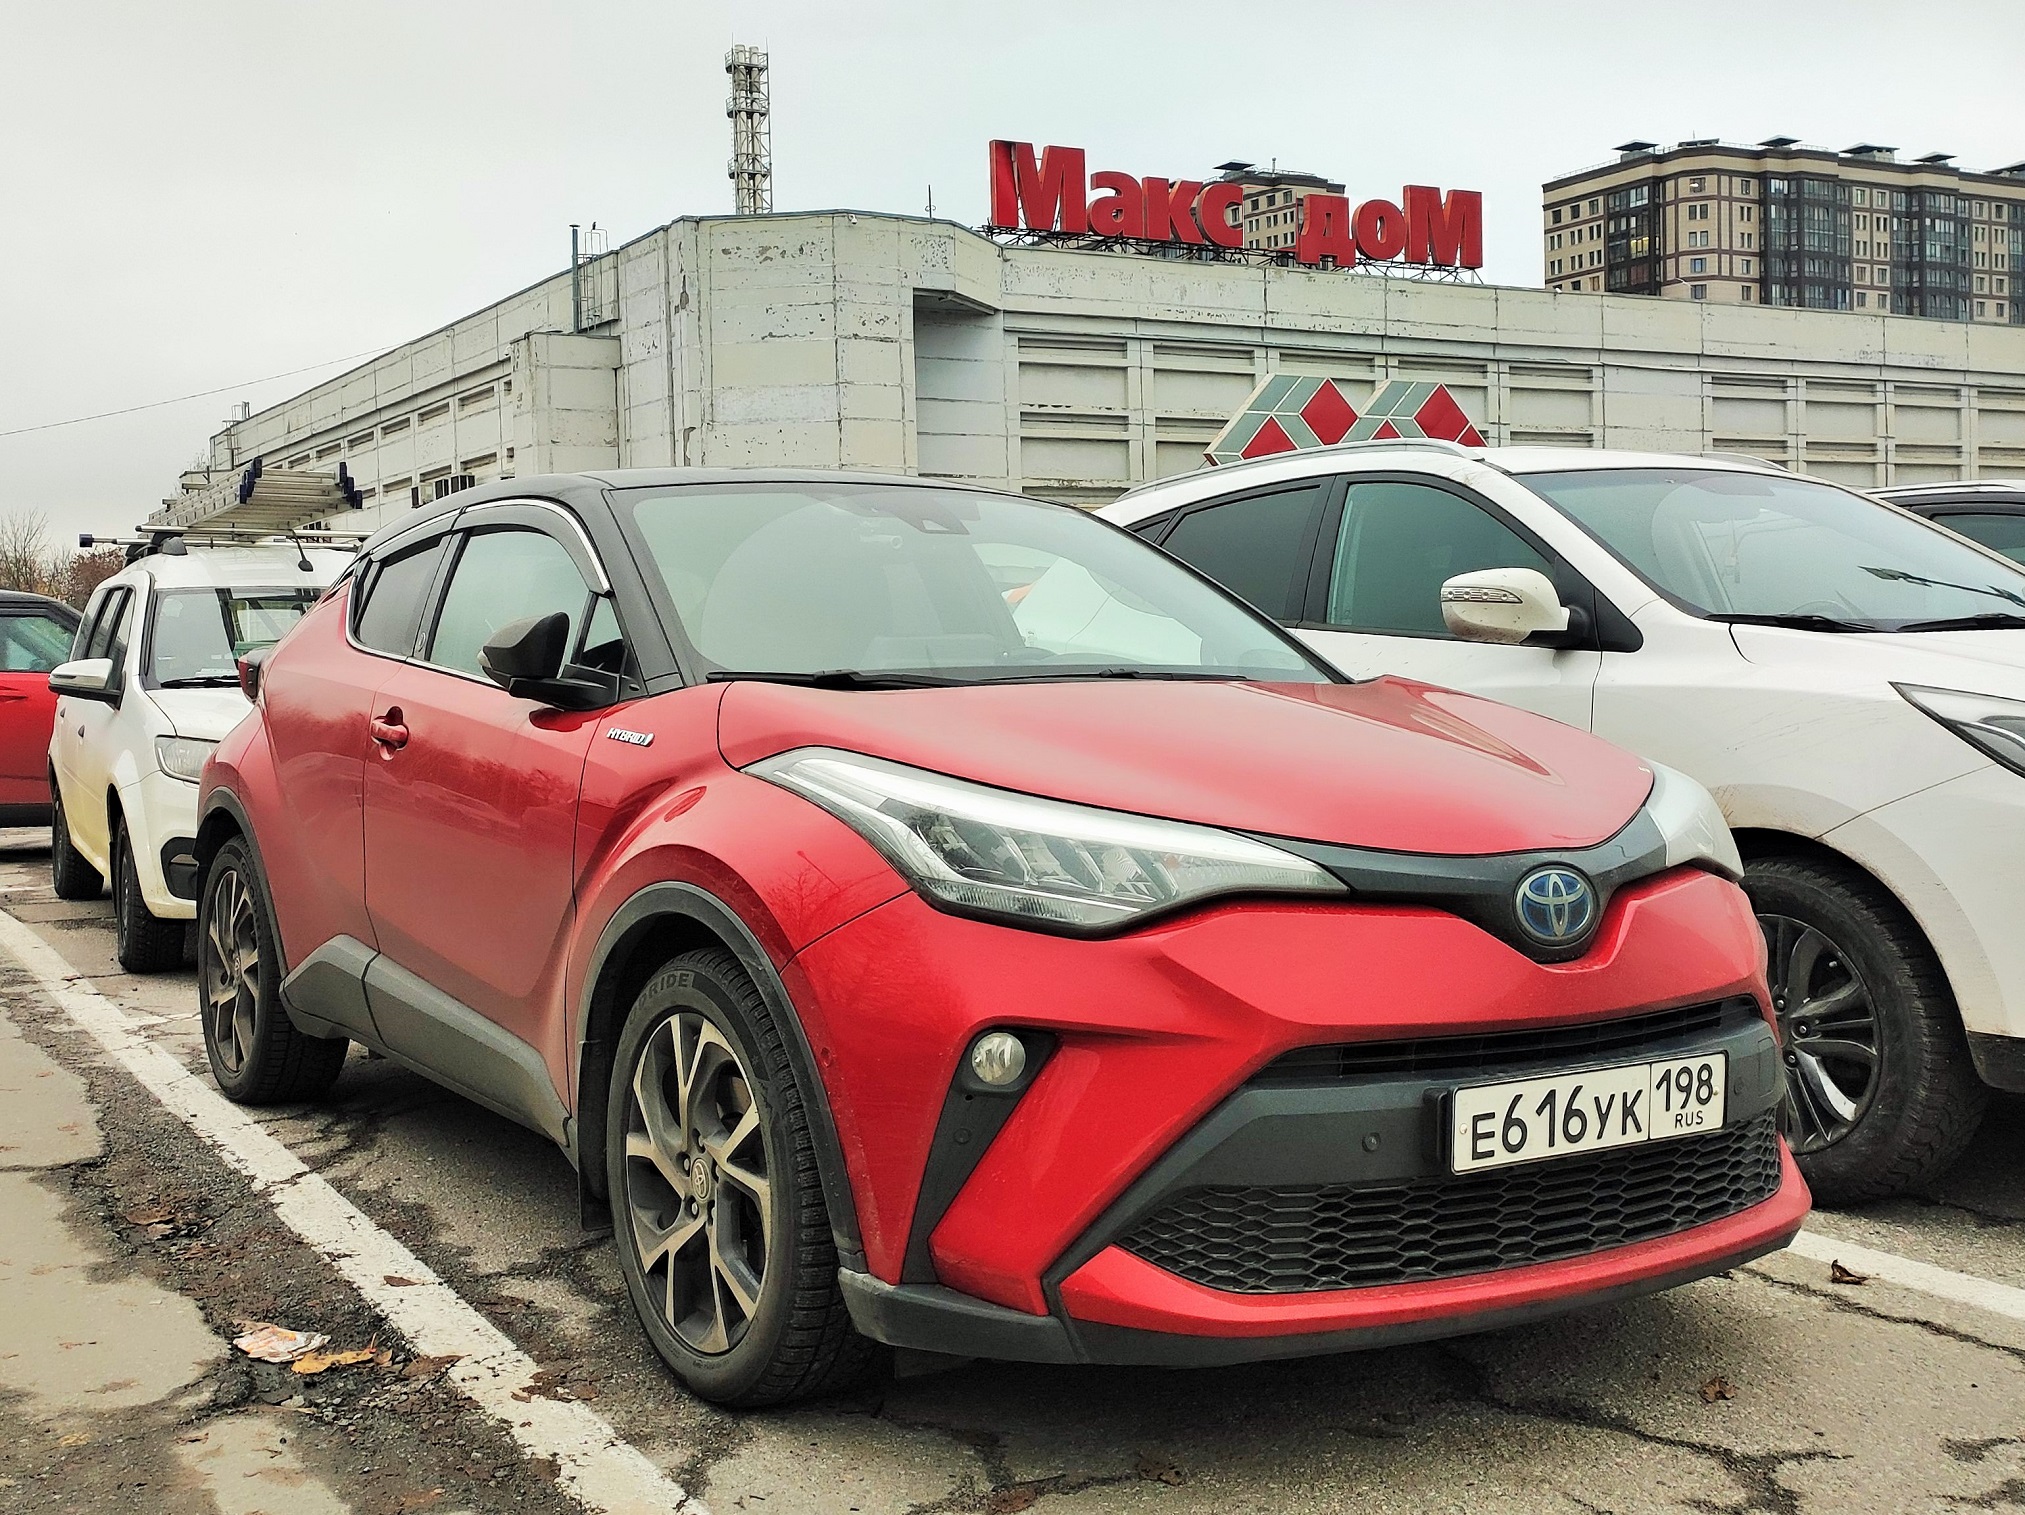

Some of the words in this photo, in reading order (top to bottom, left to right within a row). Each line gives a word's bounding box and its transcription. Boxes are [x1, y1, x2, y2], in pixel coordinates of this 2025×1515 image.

[989, 139, 1244, 247] Макс
[606, 727, 647, 745] HYBRID
[1656, 1063, 1714, 1112] 198
[1674, 1110, 1704, 1129] RUS
